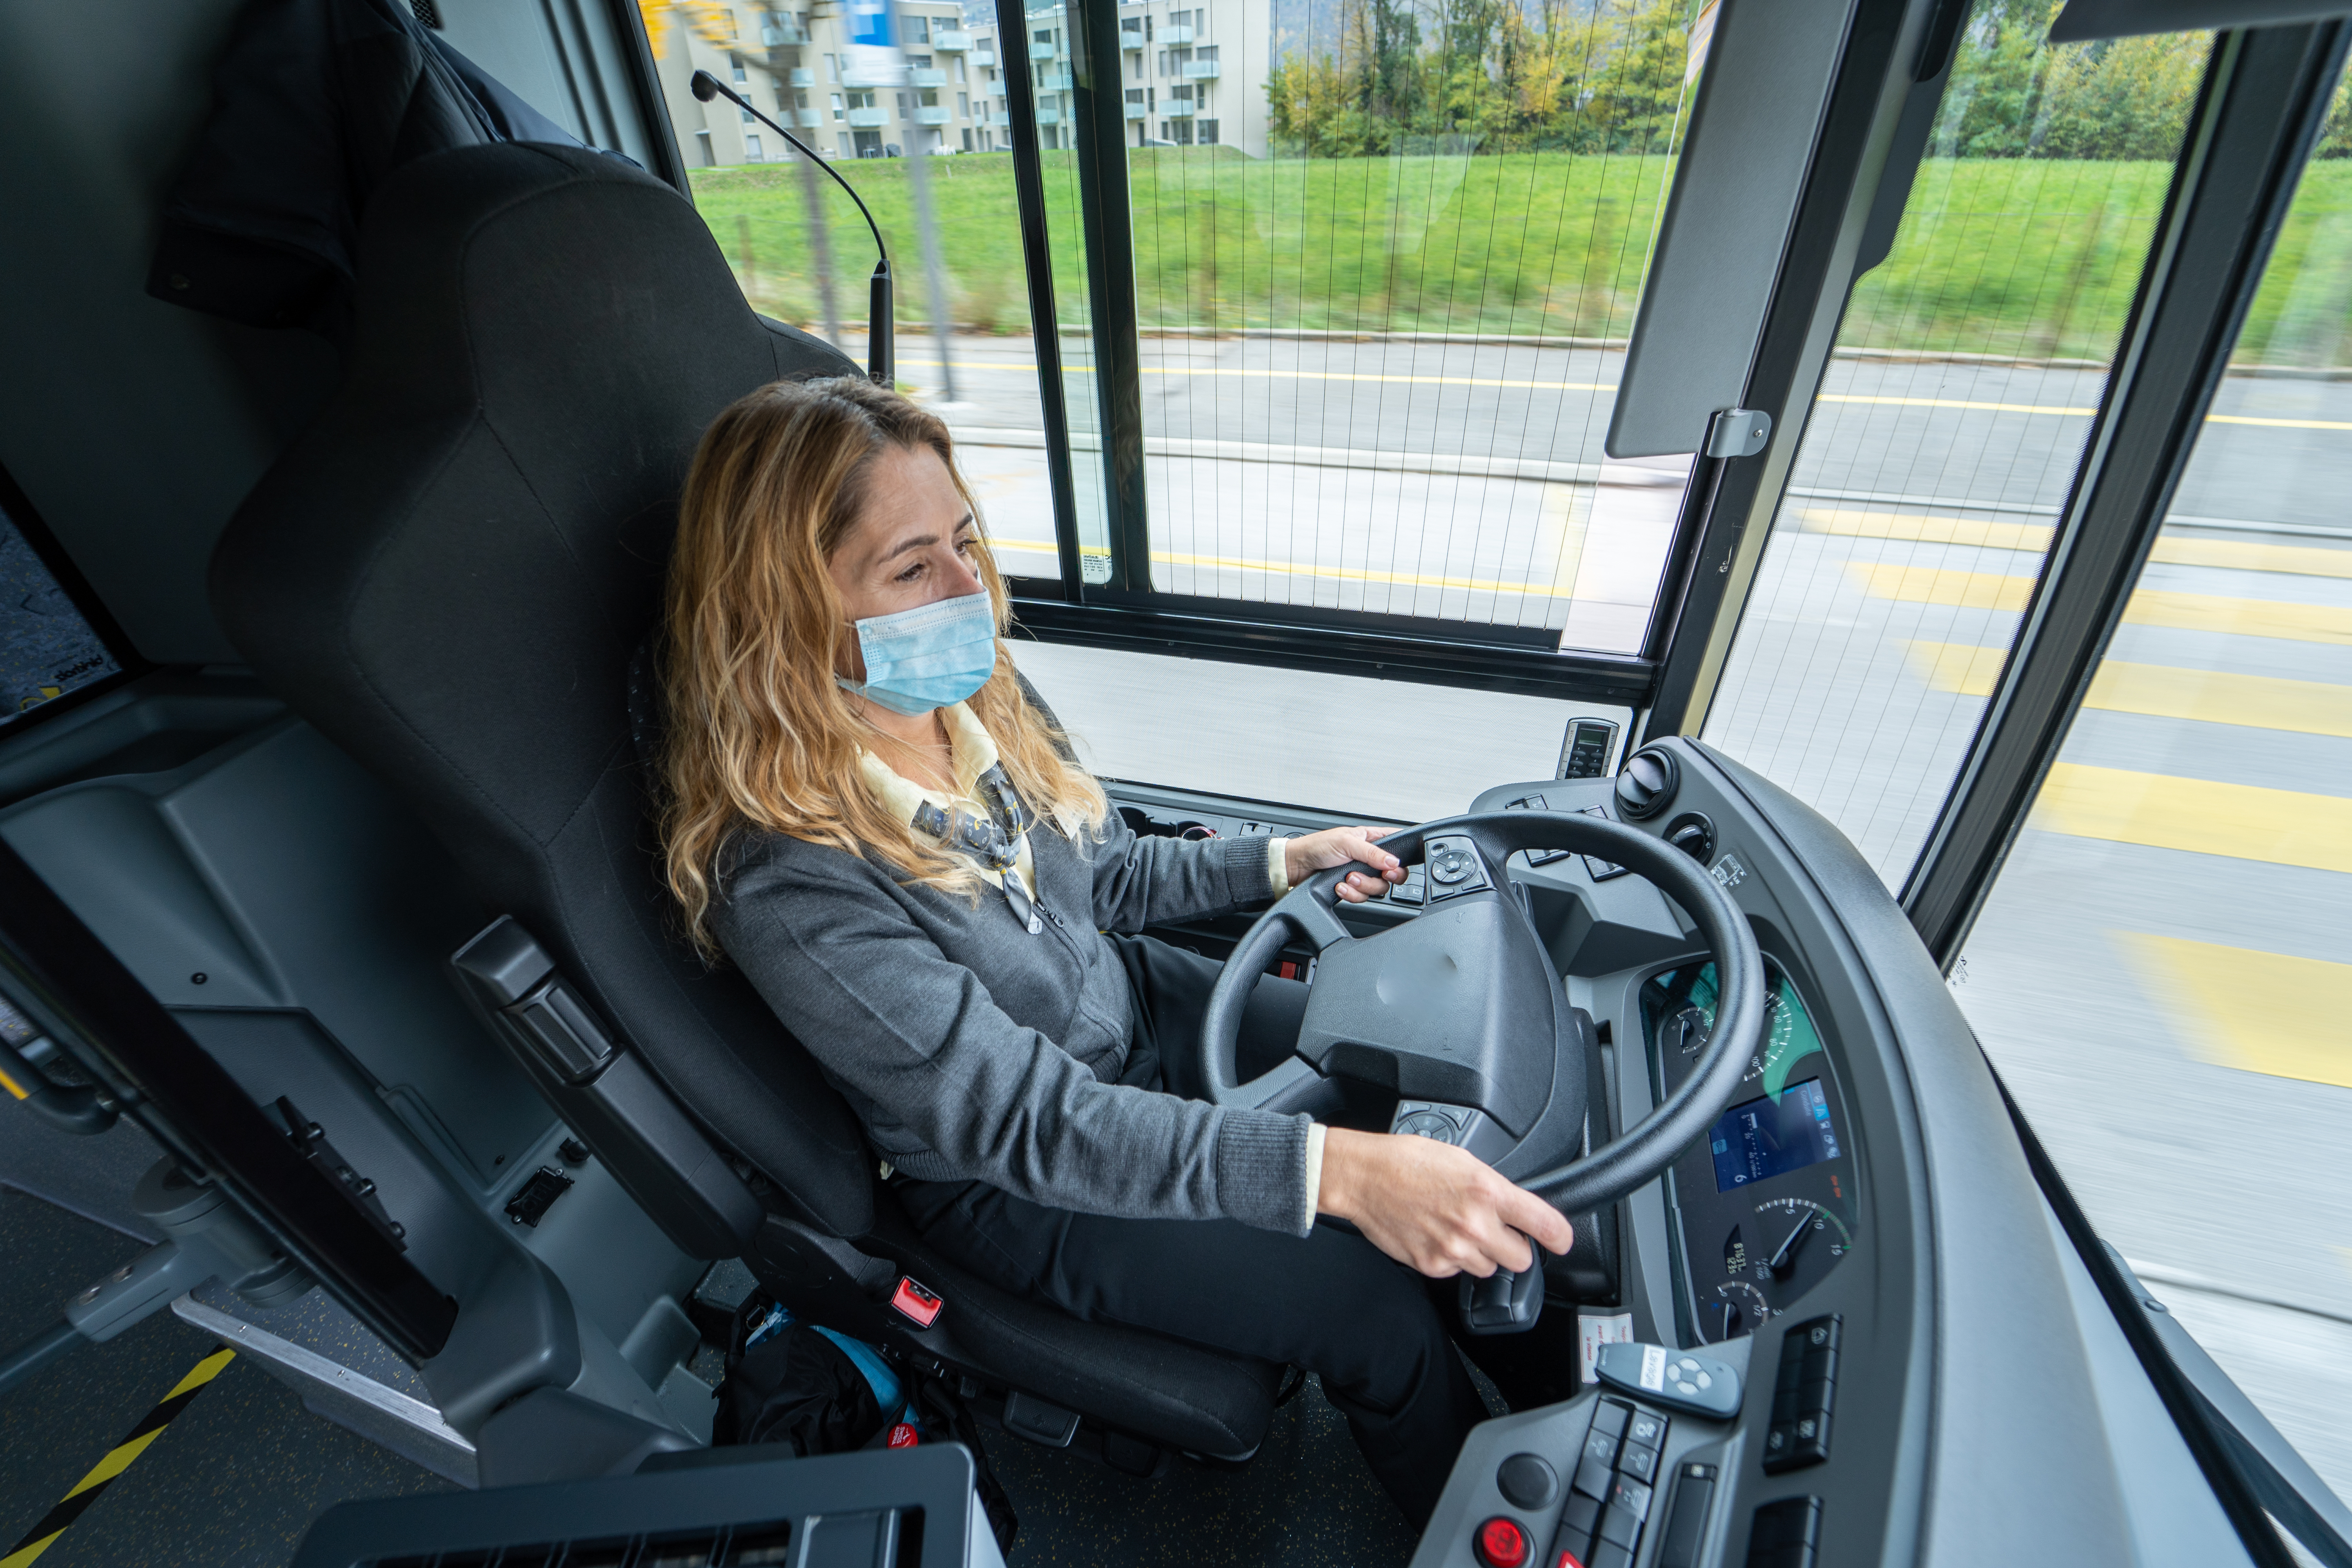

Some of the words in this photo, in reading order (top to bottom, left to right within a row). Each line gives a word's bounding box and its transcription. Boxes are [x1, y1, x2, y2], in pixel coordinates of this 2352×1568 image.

[1769, 1038, 1778, 1046] 80
[1751, 1056, 1760, 1067] 100
[1800, 1090, 1812, 1116] Conduite
[1735, 1174, 1747, 1183] 6
[1813, 1219, 1824, 1230] 10
[1830, 1244, 1843, 1256] 15
[1755, 1267, 1765, 1280] 100
[1753, 1305, 1762, 1317] 1/2
[1645, 1350, 1662, 1387] Lavage
